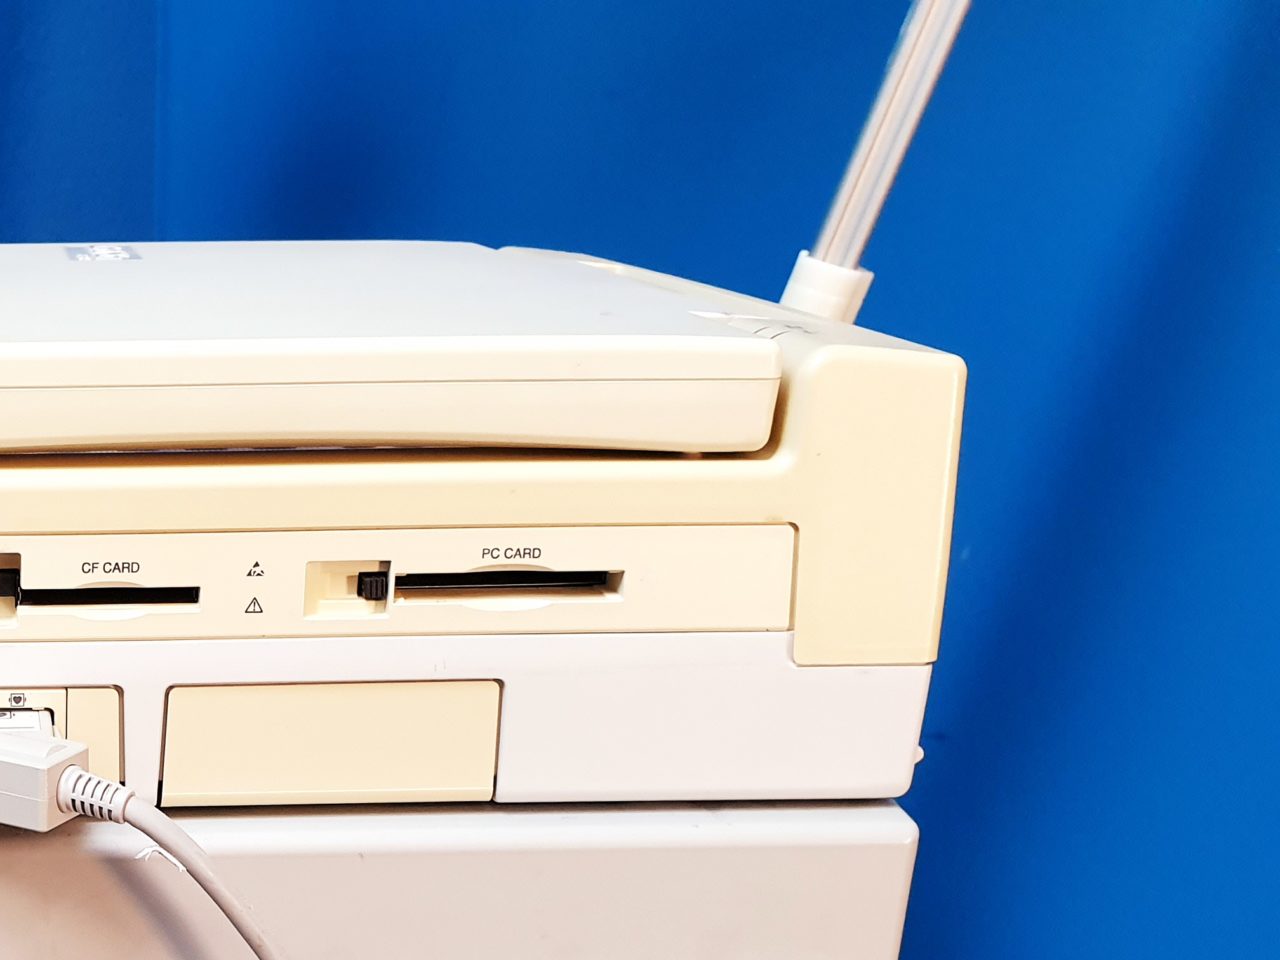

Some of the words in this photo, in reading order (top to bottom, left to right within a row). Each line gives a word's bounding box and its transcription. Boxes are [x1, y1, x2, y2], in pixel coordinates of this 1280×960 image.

[481, 547, 500, 560] PC
[504, 547, 542, 559] CARD
[81, 562, 99, 574] CF
[102, 562, 140, 574] CARD
